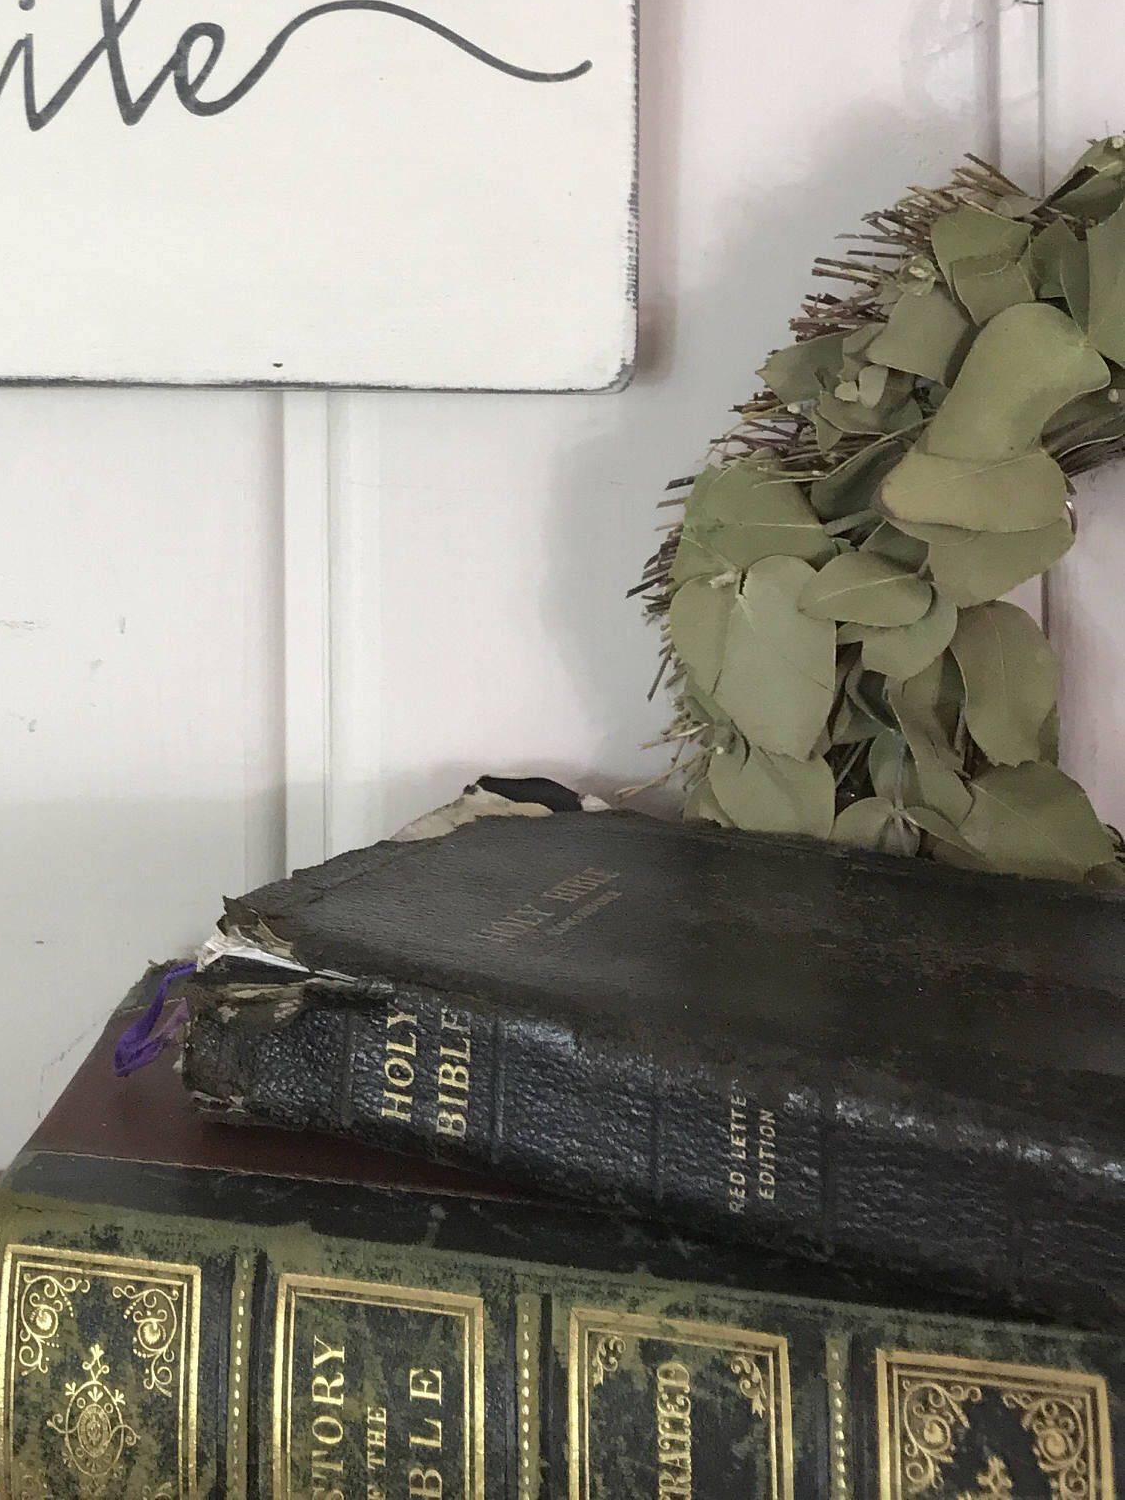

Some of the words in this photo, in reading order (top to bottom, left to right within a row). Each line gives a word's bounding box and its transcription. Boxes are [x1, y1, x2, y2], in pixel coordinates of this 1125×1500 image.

[380, 1002, 418, 1122] HOLY
[436, 1007, 472, 1141] BIBLE
[728, 1171, 747, 1216] RED
[758, 1108, 776, 1200] EDITION
[366, 1406, 387, 1470] THE
